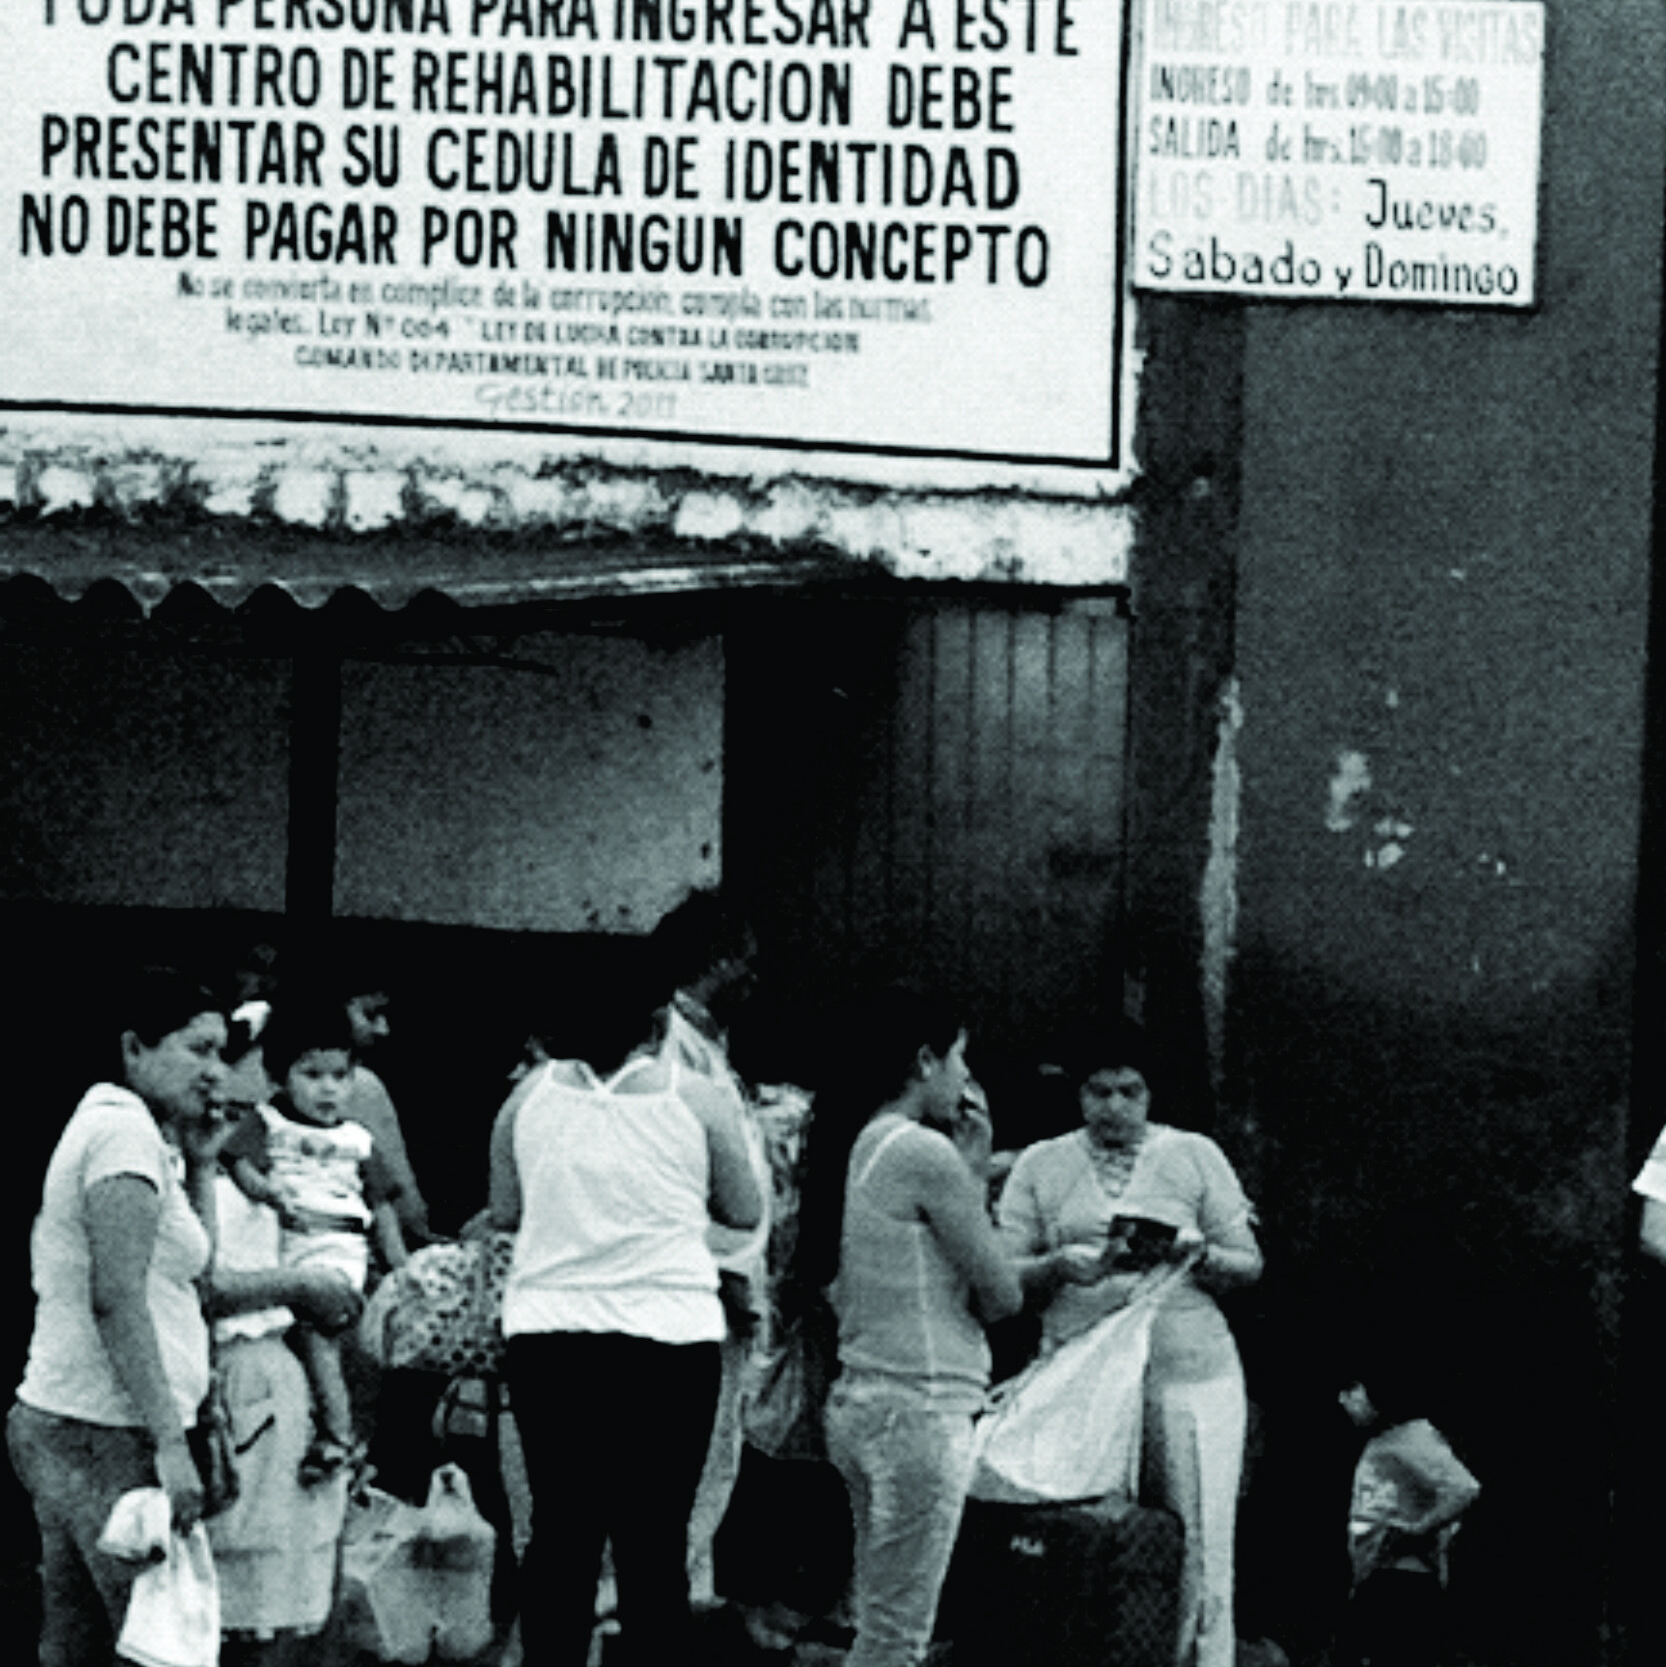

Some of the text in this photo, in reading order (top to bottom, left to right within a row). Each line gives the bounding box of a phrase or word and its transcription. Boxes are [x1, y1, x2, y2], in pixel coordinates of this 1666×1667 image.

[106, 41, 1015, 133] CENTRO DE REHABILITACION DEBE
[41, 113, 1020, 211] PRESENTAR SU CEDULA DE IDENTIDAD
[1148, 113, 1241, 161] SALIDA
[1265, 118, 1294, 163] de
[1147, 169, 1214, 222] LOS
[19, 194, 1049, 289] NO DEBE PAGAR POR NINGUN CONCEPTO
[1335, 265, 1352, 293] y
[1364, 240, 1520, 296] Domingo
